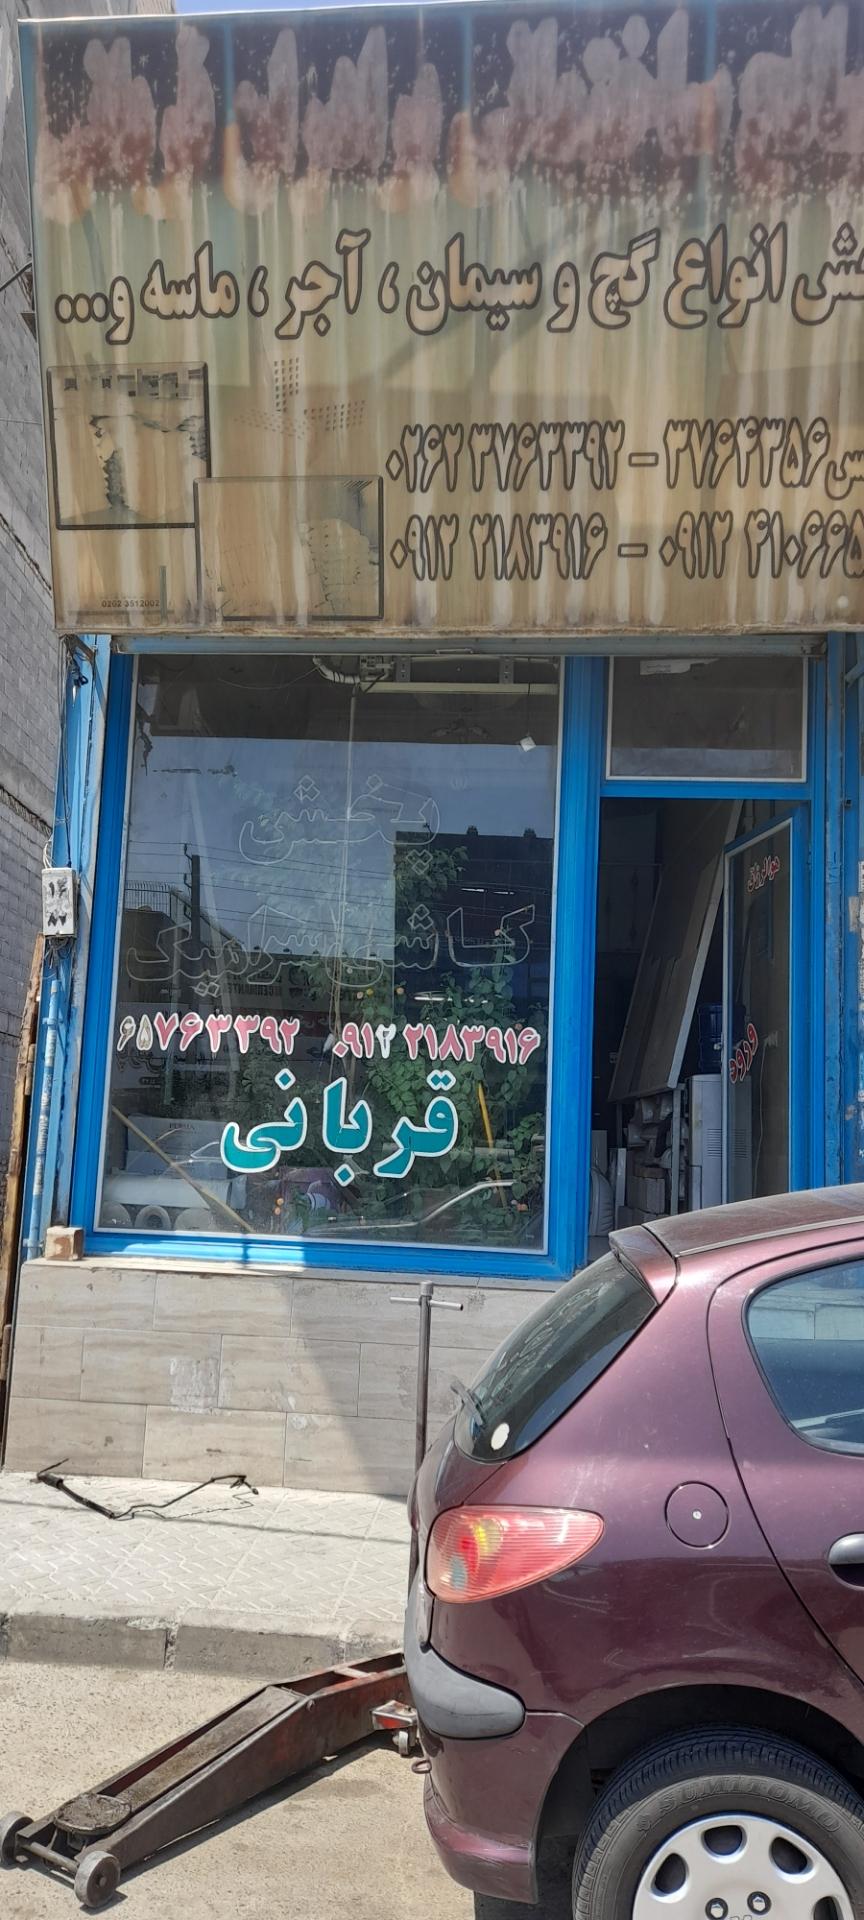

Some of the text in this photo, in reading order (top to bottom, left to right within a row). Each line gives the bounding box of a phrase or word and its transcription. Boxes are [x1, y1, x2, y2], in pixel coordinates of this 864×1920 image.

[140, 240, 240, 320] ماسه
[546, 261, 580, 333] و
[588, 227, 660, 330] گچ
[664, 220, 787, 329] انواع
[386, 422, 464, 493] ۰۲۶۲
[468, 419, 626, 492] ۳۷۶۳۳۹۲
[663, 416, 831, 489] ۳۷۶۴۳۵۶
[390, 514, 460, 581] ۰۹۱۲
[469, 512, 608, 580] ۲۱۸۳۹۱۶
[659, 510, 734, 579] ۰۹۱۲
[239, 774, 440, 876] پخش
[324, 903, 536, 987] کاشی
[332, 1022, 397, 1059] ۰۹۱۲
[402, 1023, 541, 1065] ۲۱۸۳۹۱۶
[729, 1022, 759, 1084] ورود
[220, 1067, 459, 1187] قربانی
[658, 1774, 843, 1834] SUMITOMO
